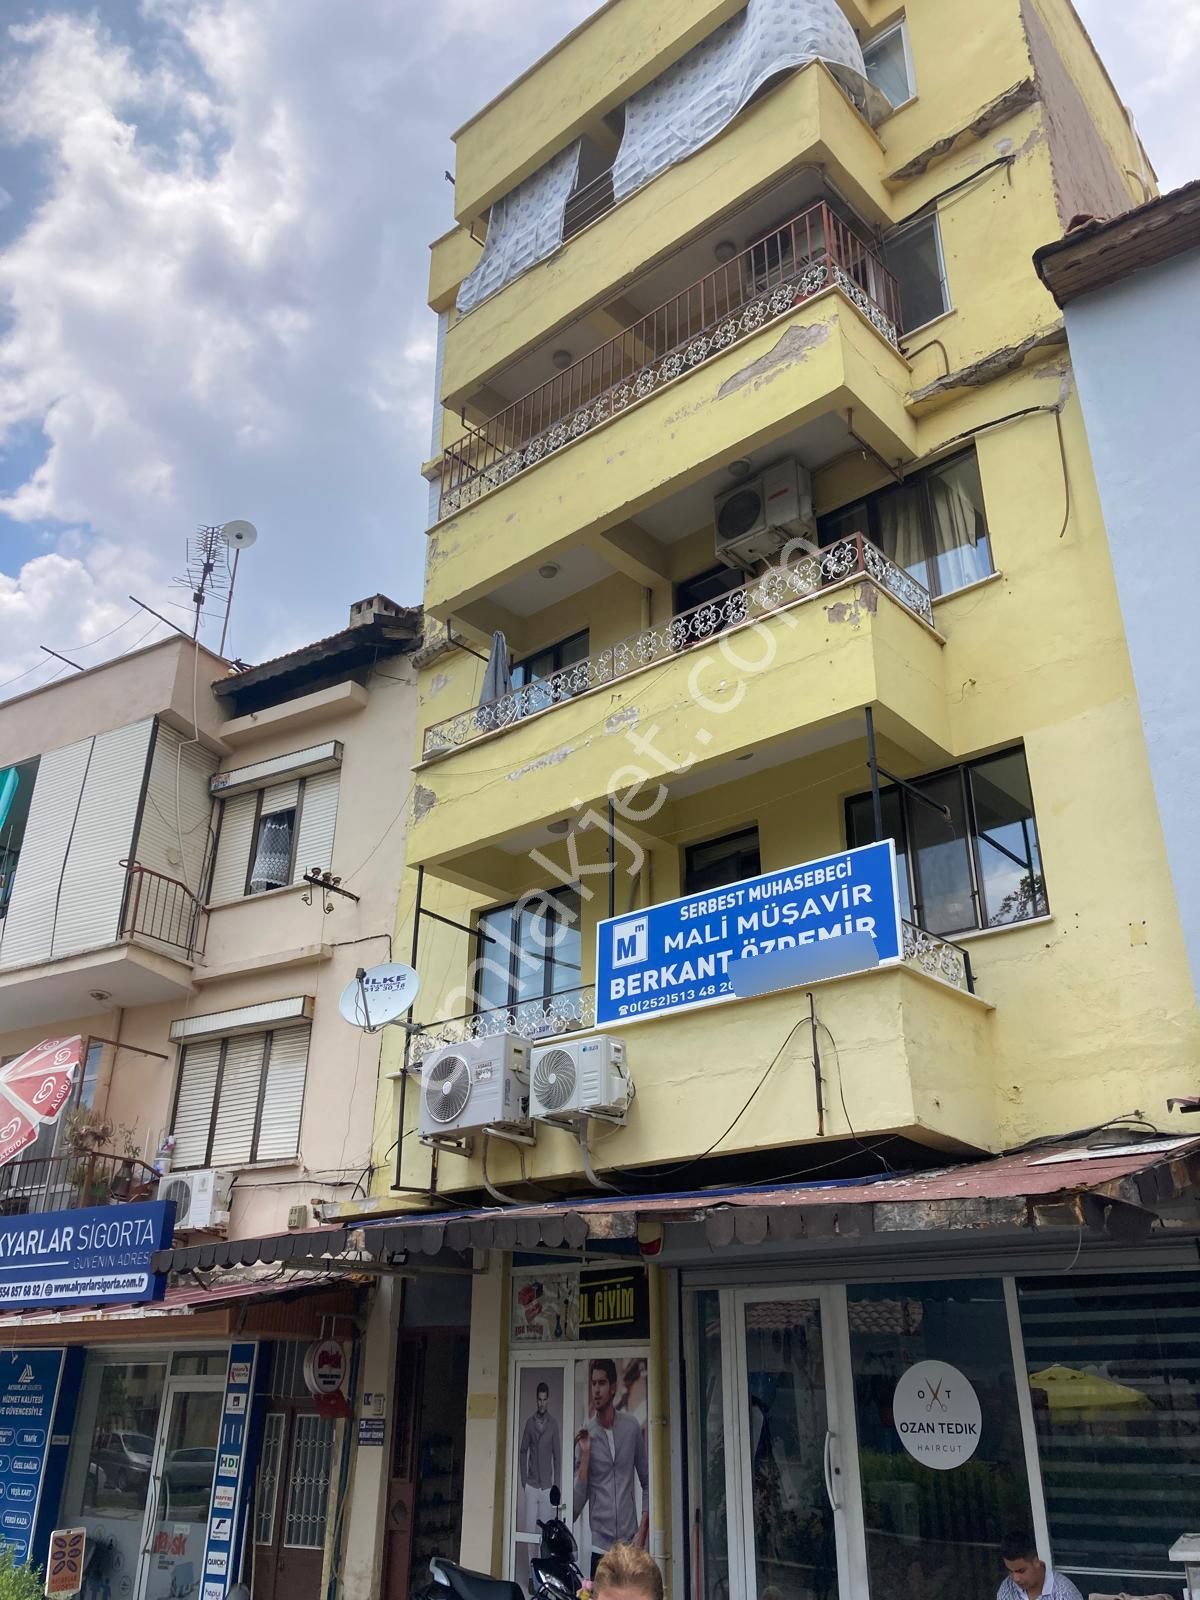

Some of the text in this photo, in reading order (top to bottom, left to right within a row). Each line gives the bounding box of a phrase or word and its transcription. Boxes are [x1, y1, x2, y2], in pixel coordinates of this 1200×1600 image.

[680, 857, 852, 921] SERBEST MUHASEBECİ
[664, 884, 872, 954] MALİ MÜŞAVİR
[610, 949, 733, 1001] BERKANT
[699, 985, 715, 997] 48
[77, 1218, 154, 1251] SİGORTA
[54, 1276, 145, 1294] www.akyarlarsigorta.com.tr
[595, 1284, 634, 1321] GİYİM
[917, 1390, 952, 1400] O T
[900, 1422, 977, 1435] OZAN TEDIK
[917, 1444, 962, 1453] HAIRCUT
[220, 1456, 238, 1468] HDI
